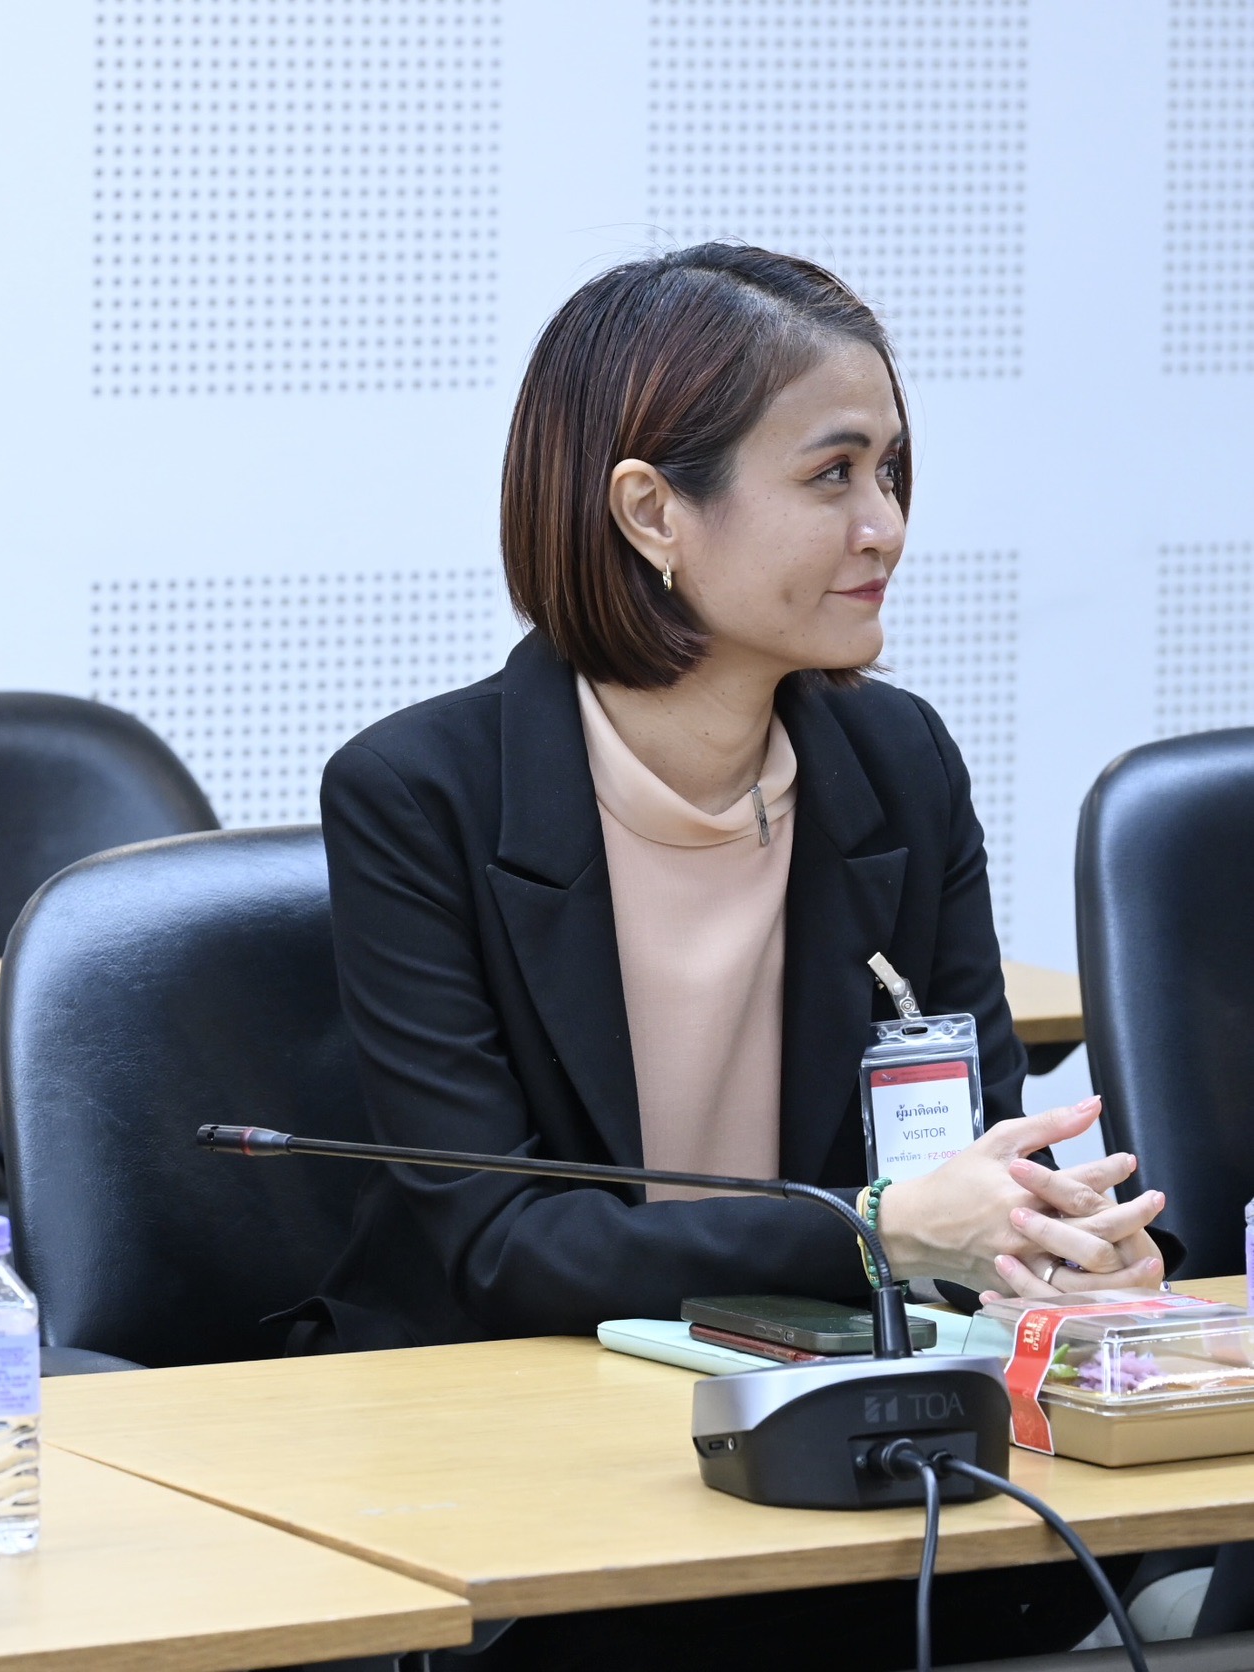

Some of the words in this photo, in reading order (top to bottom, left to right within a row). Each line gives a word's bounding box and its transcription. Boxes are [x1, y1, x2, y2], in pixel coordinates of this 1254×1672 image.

[896, 1101, 949, 1121] ผู้มาติดต่อ
[902, 1127, 946, 1140] VISITOR
[886, 1150, 921, 1163] เลขที่บัตร
[906, 1391, 965, 1420] TOA
